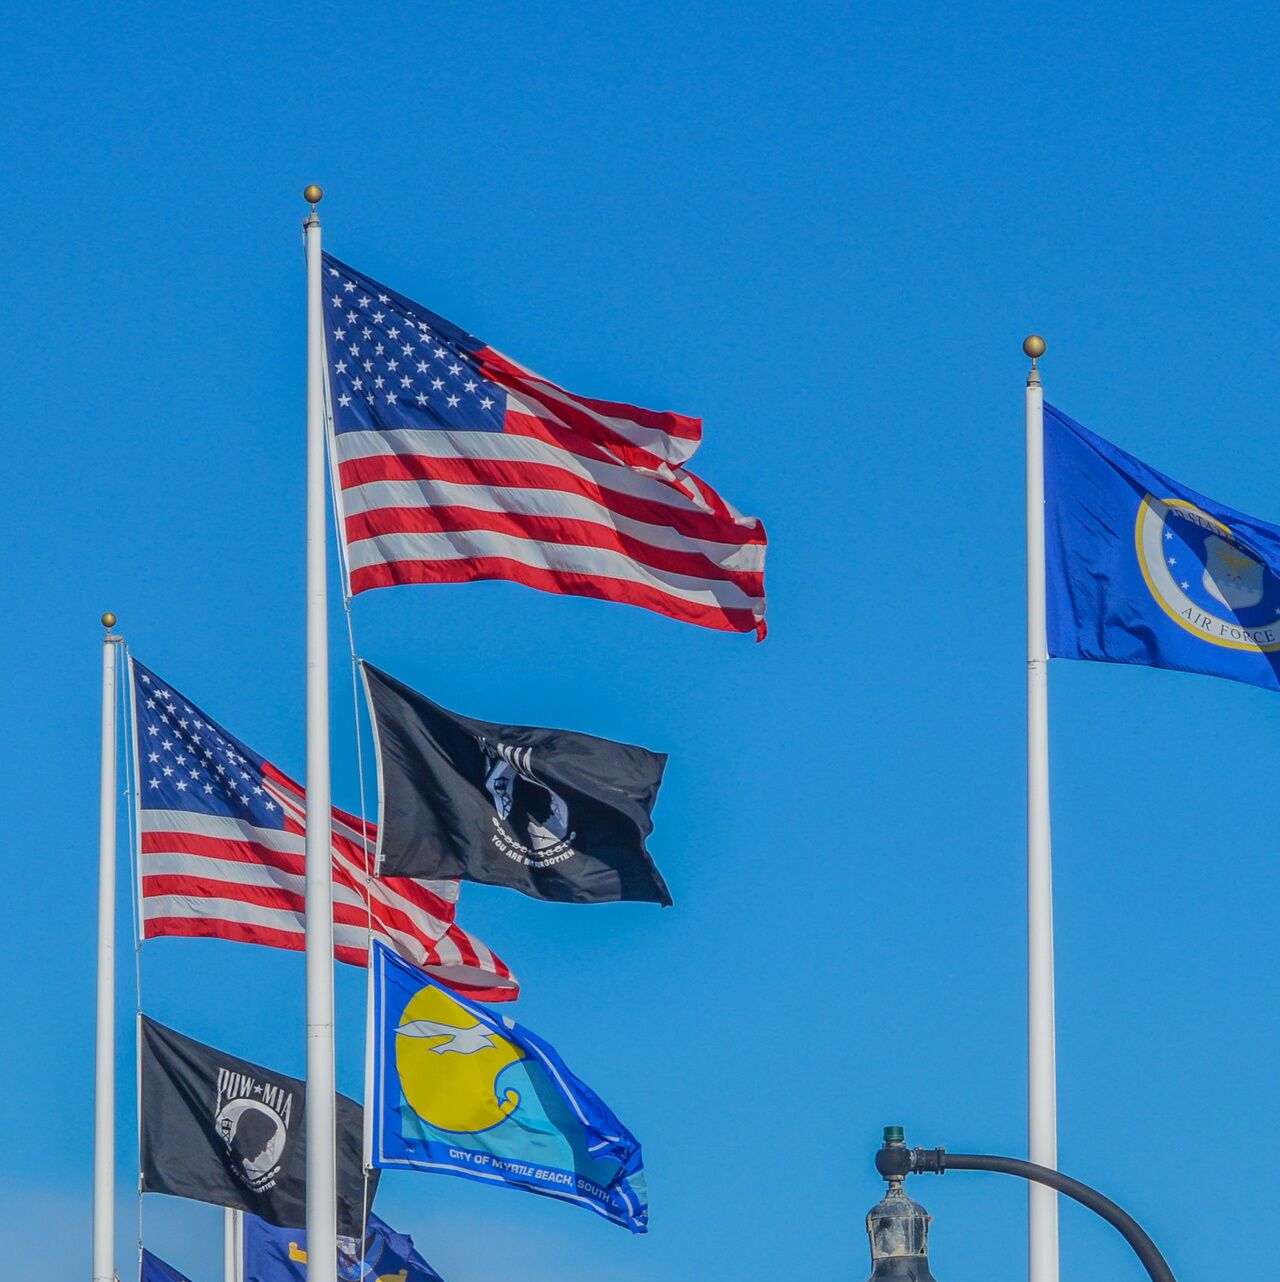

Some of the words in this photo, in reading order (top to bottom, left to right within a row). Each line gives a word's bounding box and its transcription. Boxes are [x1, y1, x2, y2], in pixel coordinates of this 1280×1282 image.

[1181, 607, 1212, 631] AIR
[1220, 623, 1276, 644] FORCE
[492, 834, 507, 851] YOU
[505, 849, 523, 863] ARE
[214, 1066, 256, 1118] POW
[261, 1082, 294, 1131] MIA
[449, 1149, 472, 1162] CITY
[474, 1154, 490, 1165] OF
[491, 1158, 535, 1177] MYRTLE
[534, 1169, 574, 1188] BEACH,
[576, 1179, 611, 1203] SOUTH
